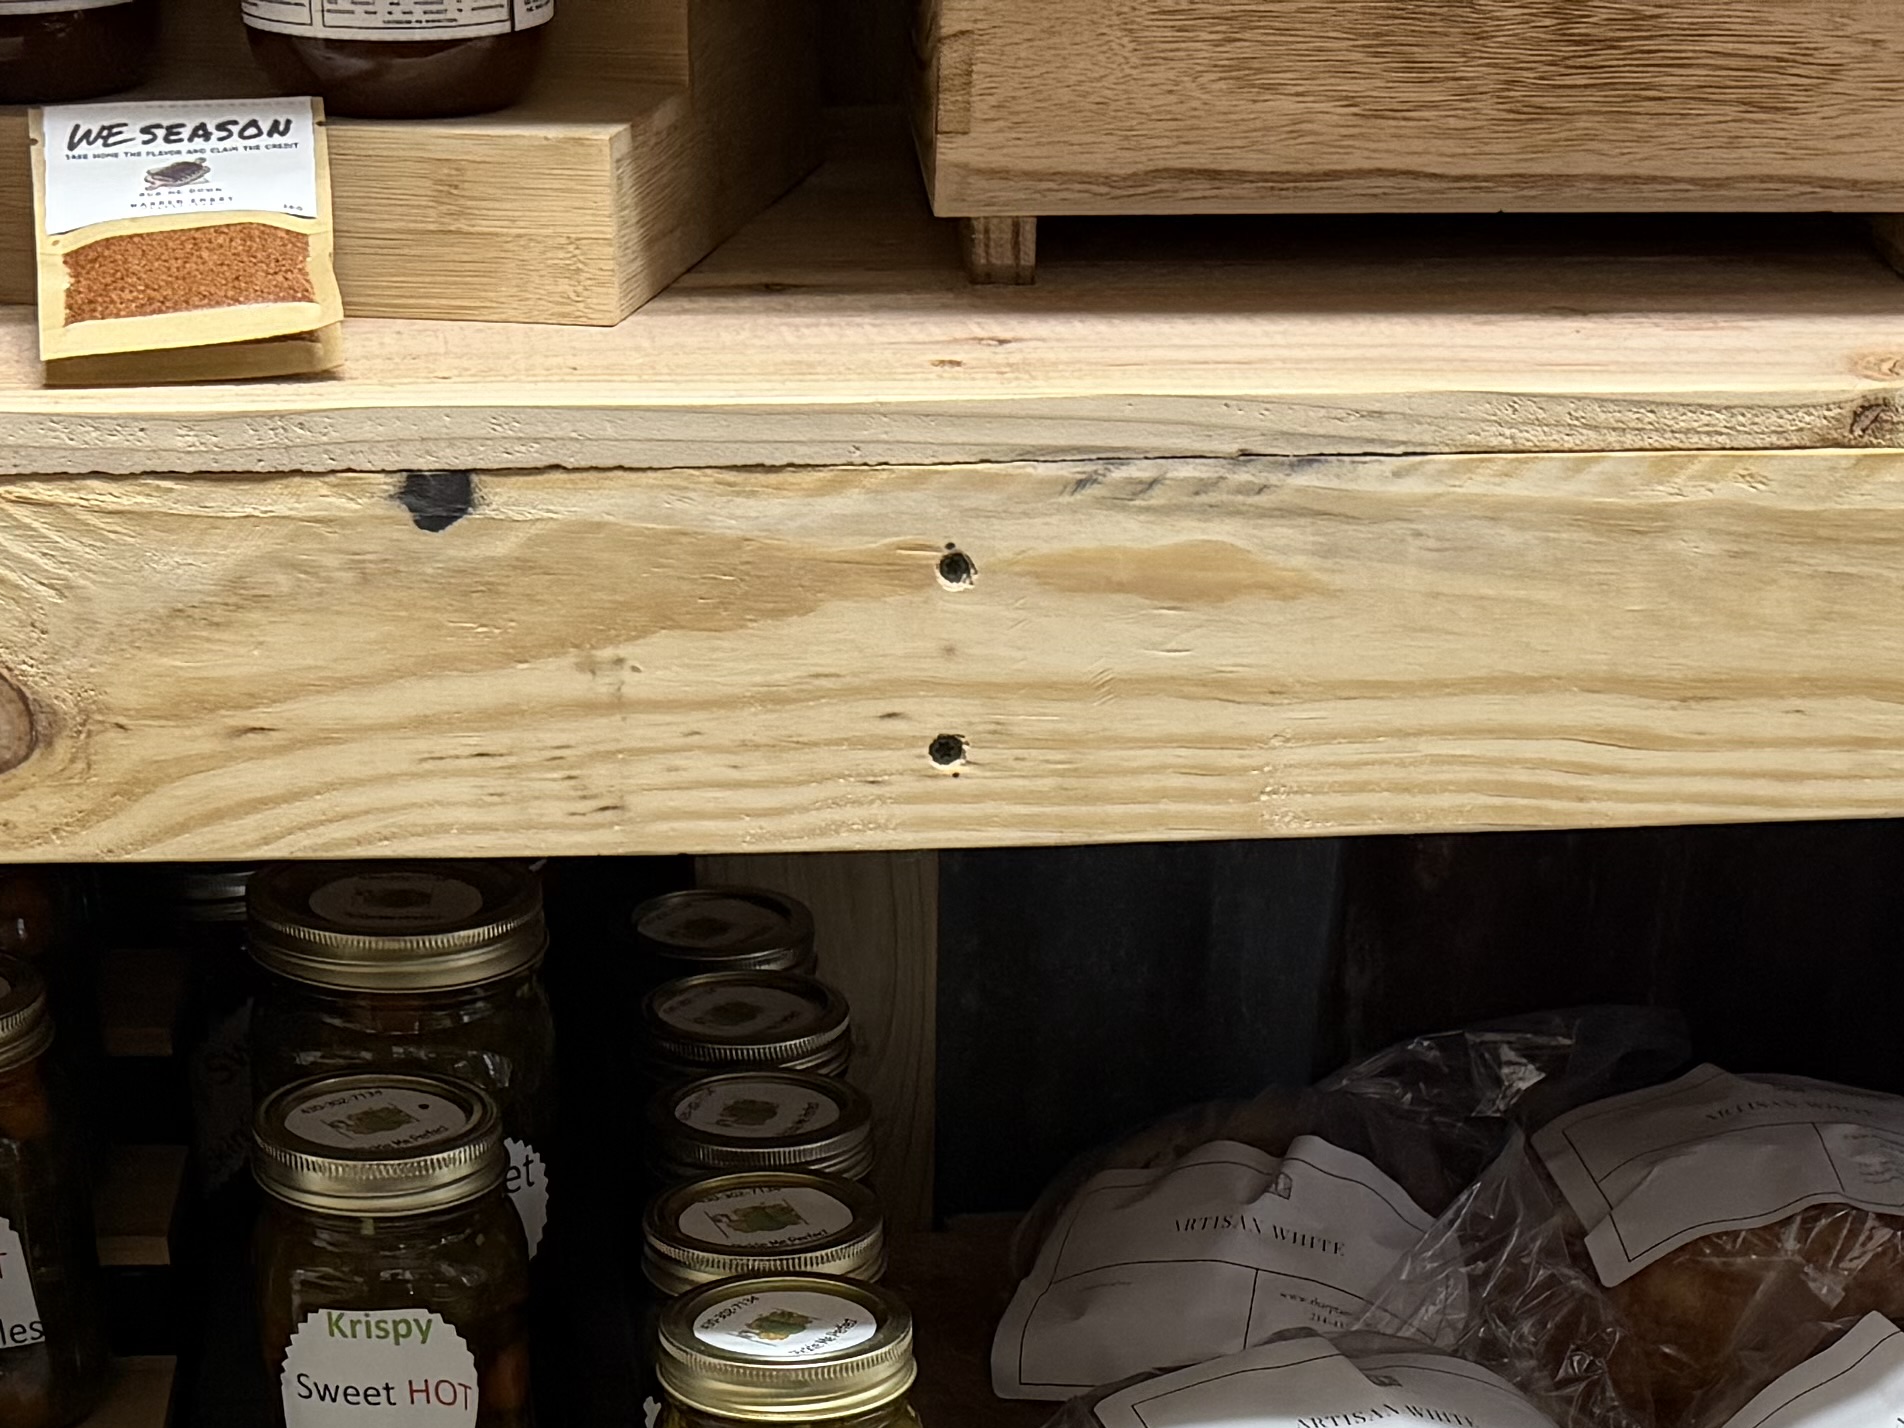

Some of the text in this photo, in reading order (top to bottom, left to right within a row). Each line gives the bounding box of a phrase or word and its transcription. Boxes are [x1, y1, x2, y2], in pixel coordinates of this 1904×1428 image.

[139, 117, 293, 145] SEASON
[327, 1311, 434, 1347] Krispy
[296, 1373, 473, 1412] Sweet HOT
